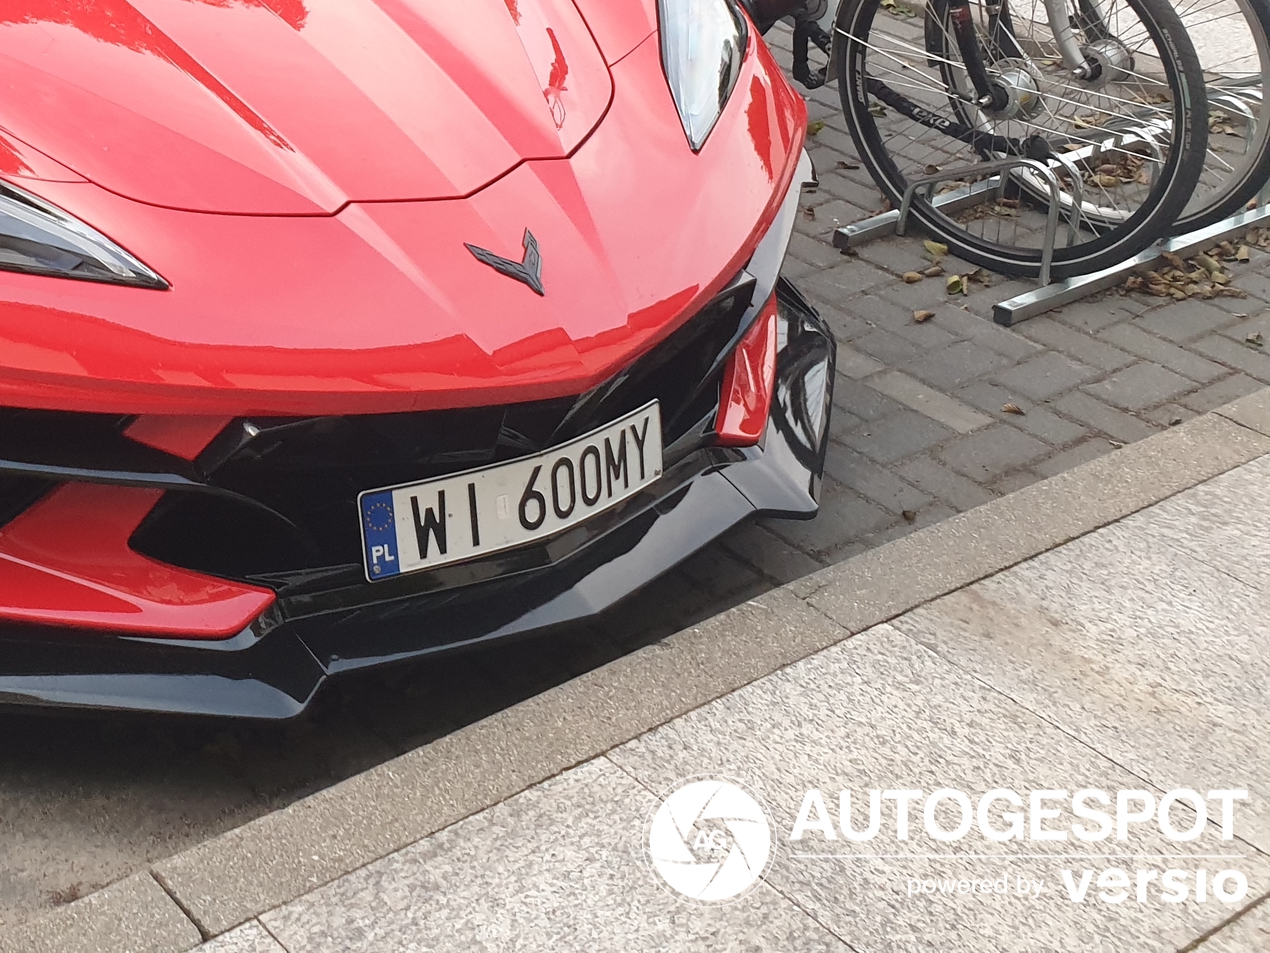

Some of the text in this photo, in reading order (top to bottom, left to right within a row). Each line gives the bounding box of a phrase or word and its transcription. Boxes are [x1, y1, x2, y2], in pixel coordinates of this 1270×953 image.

[410, 416, 650, 560] WI 600MY
[371, 545, 394, 564] PL
